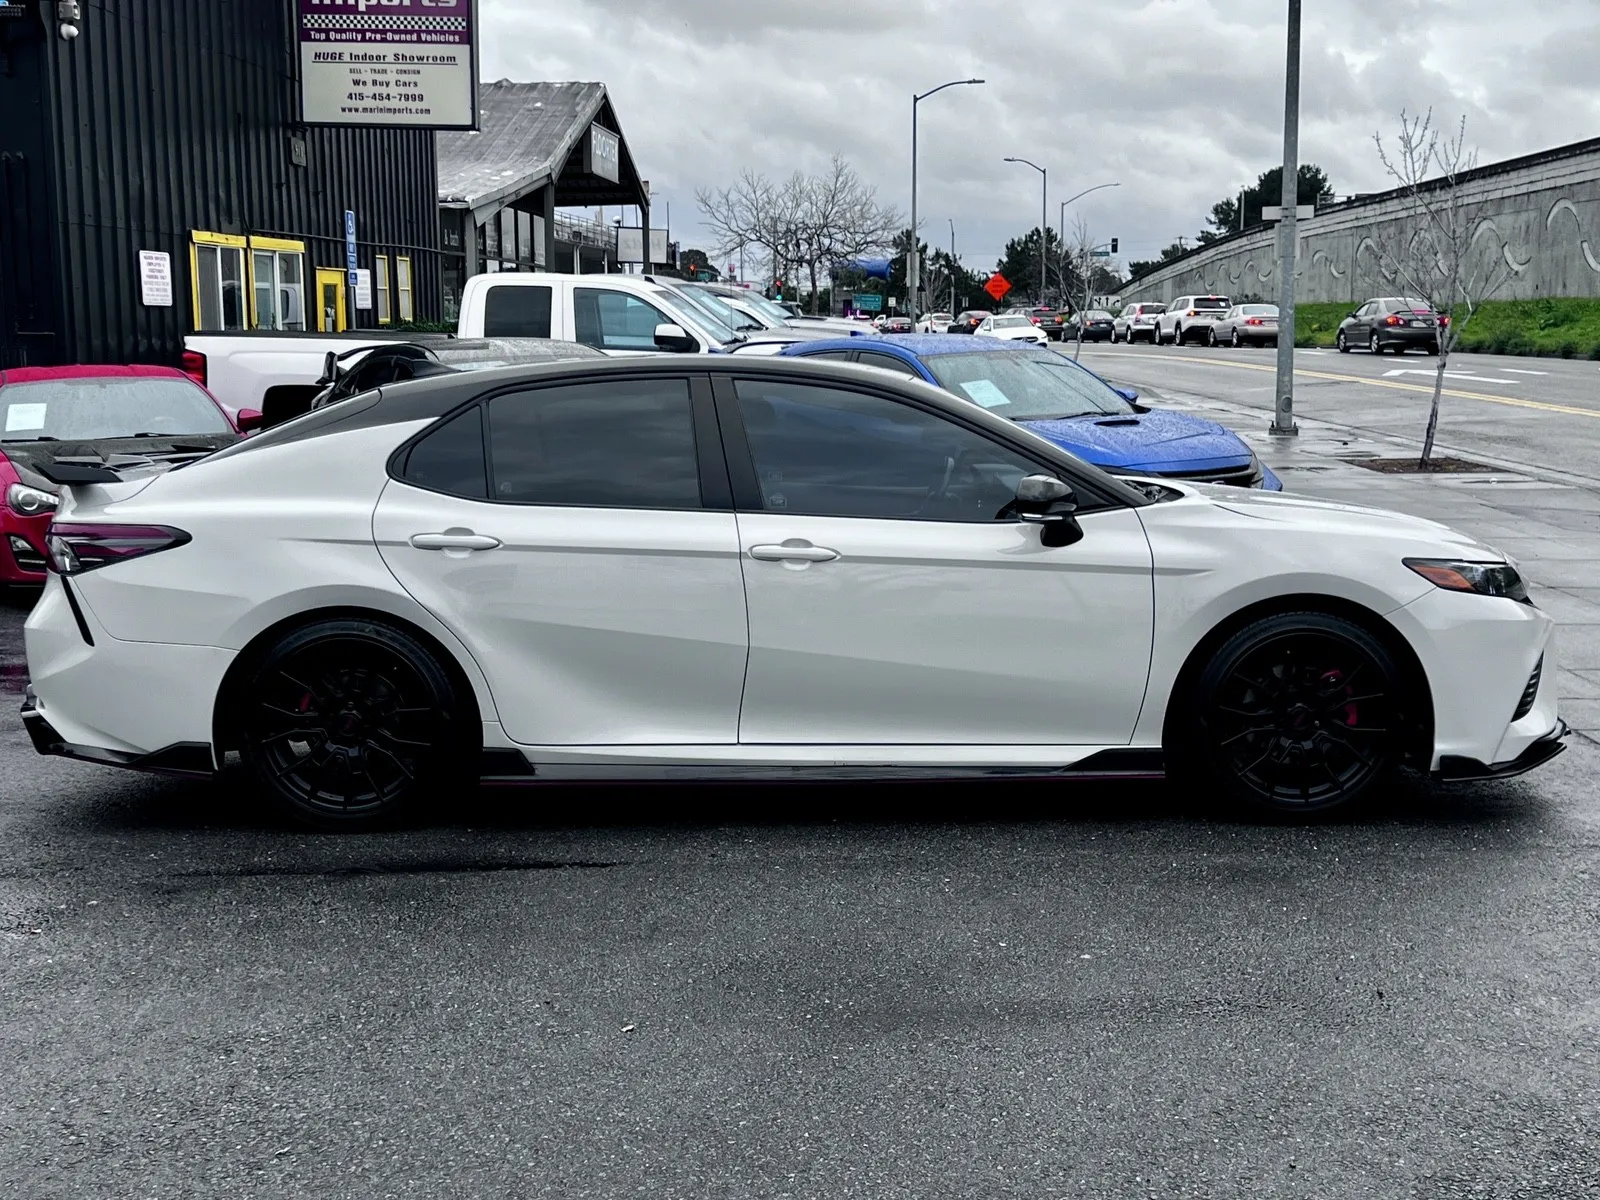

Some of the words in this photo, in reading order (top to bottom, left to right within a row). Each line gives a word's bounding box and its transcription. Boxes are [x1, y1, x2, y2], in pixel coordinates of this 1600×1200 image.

[310, 31, 326, 40] Top
[329, 31, 362, 41] Quality
[365, 32, 417, 41] Pre-Owned
[421, 32, 460, 42] Vehicles
[314, 52, 345, 60] HUGE
[349, 52, 388, 61] Indoor
[393, 53, 456, 62] Showroom
[352, 78, 367, 87] We
[372, 79, 390, 88] Buy
[395, 79, 418, 88] Cars
[347, 92, 424, 102] 415-454-7999
[341, 106, 431, 115] www.marinimports.com
